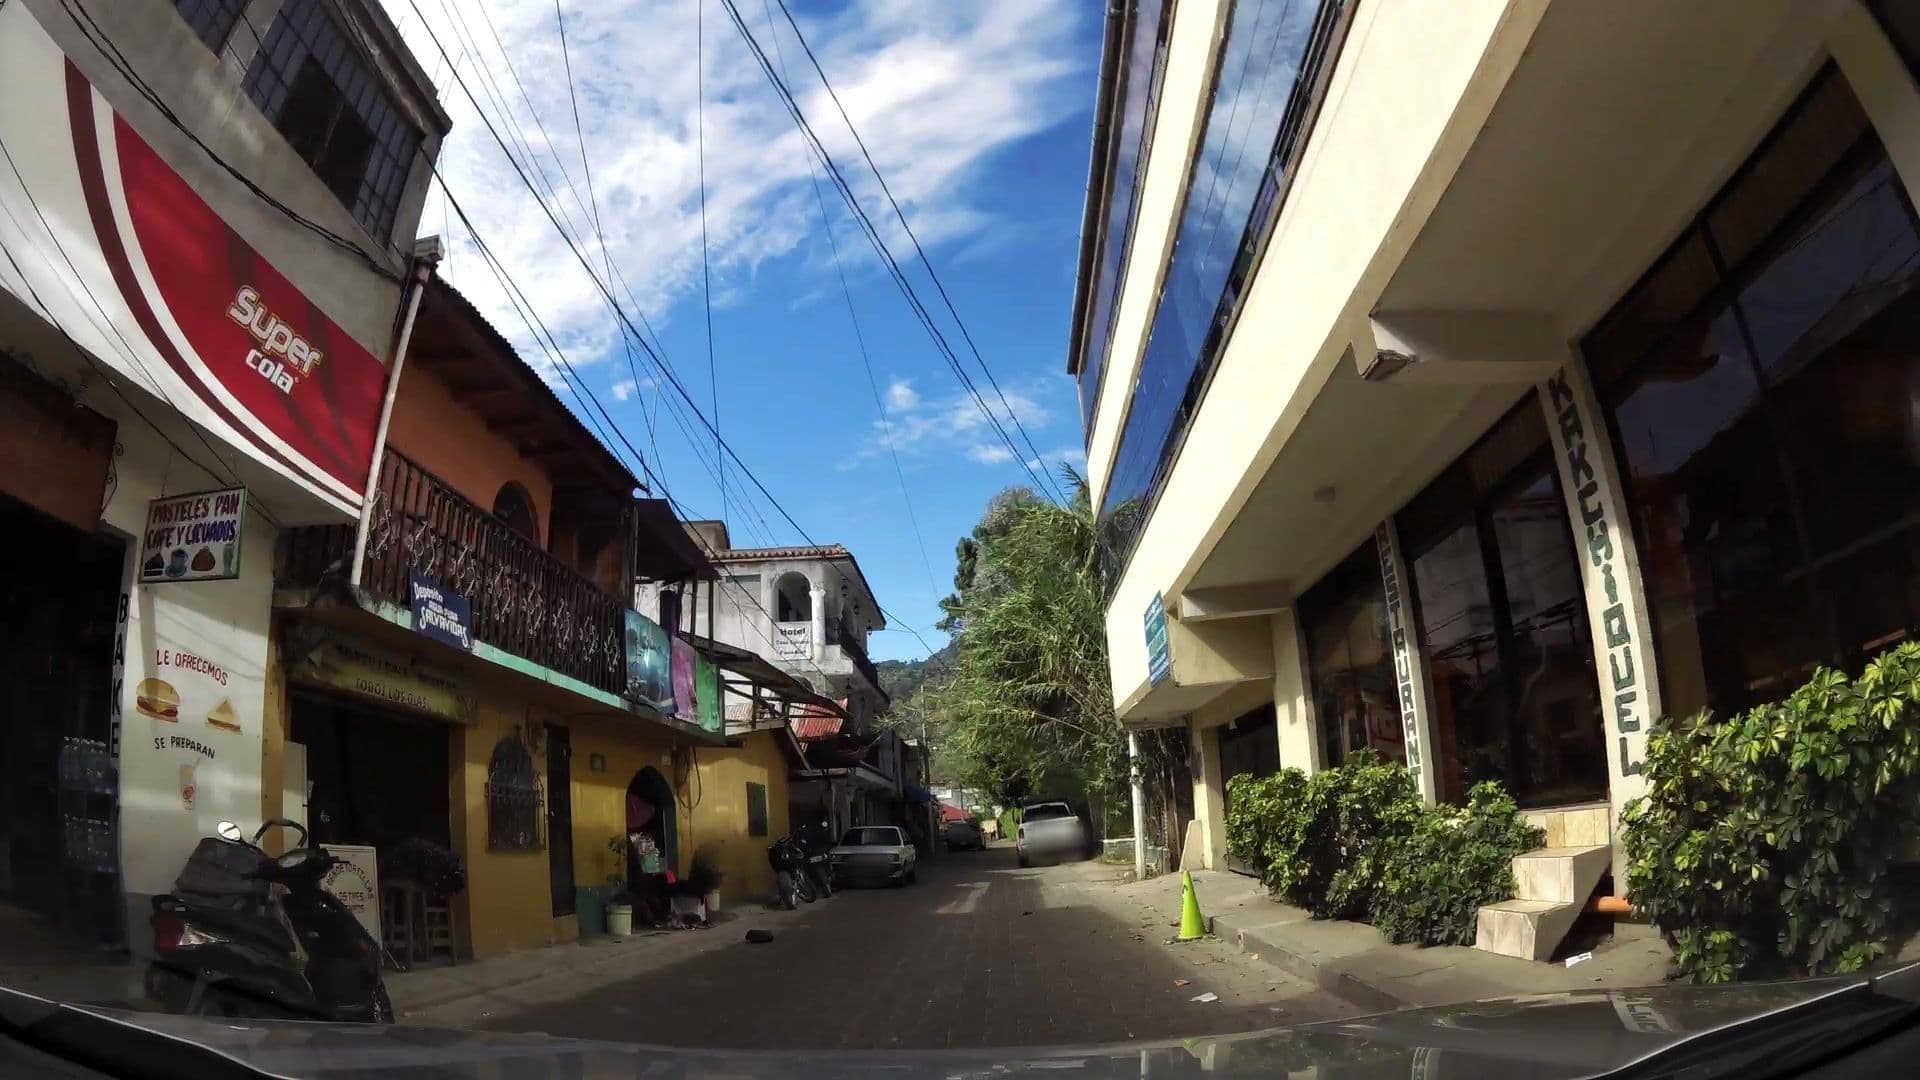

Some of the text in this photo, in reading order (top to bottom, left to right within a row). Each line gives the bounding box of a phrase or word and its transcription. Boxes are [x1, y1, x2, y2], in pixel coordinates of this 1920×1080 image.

[226, 285, 323, 377] Super
[152, 493, 240, 524] PASTELES PAN
[177, 525, 186, 546] Y
[419, 606, 469, 648] SALVAVIDAS
[779, 627, 806, 637] Hotel
[156, 649, 229, 686] LE OFRECEMOS
[154, 736, 216, 759] SE PREPARAN
